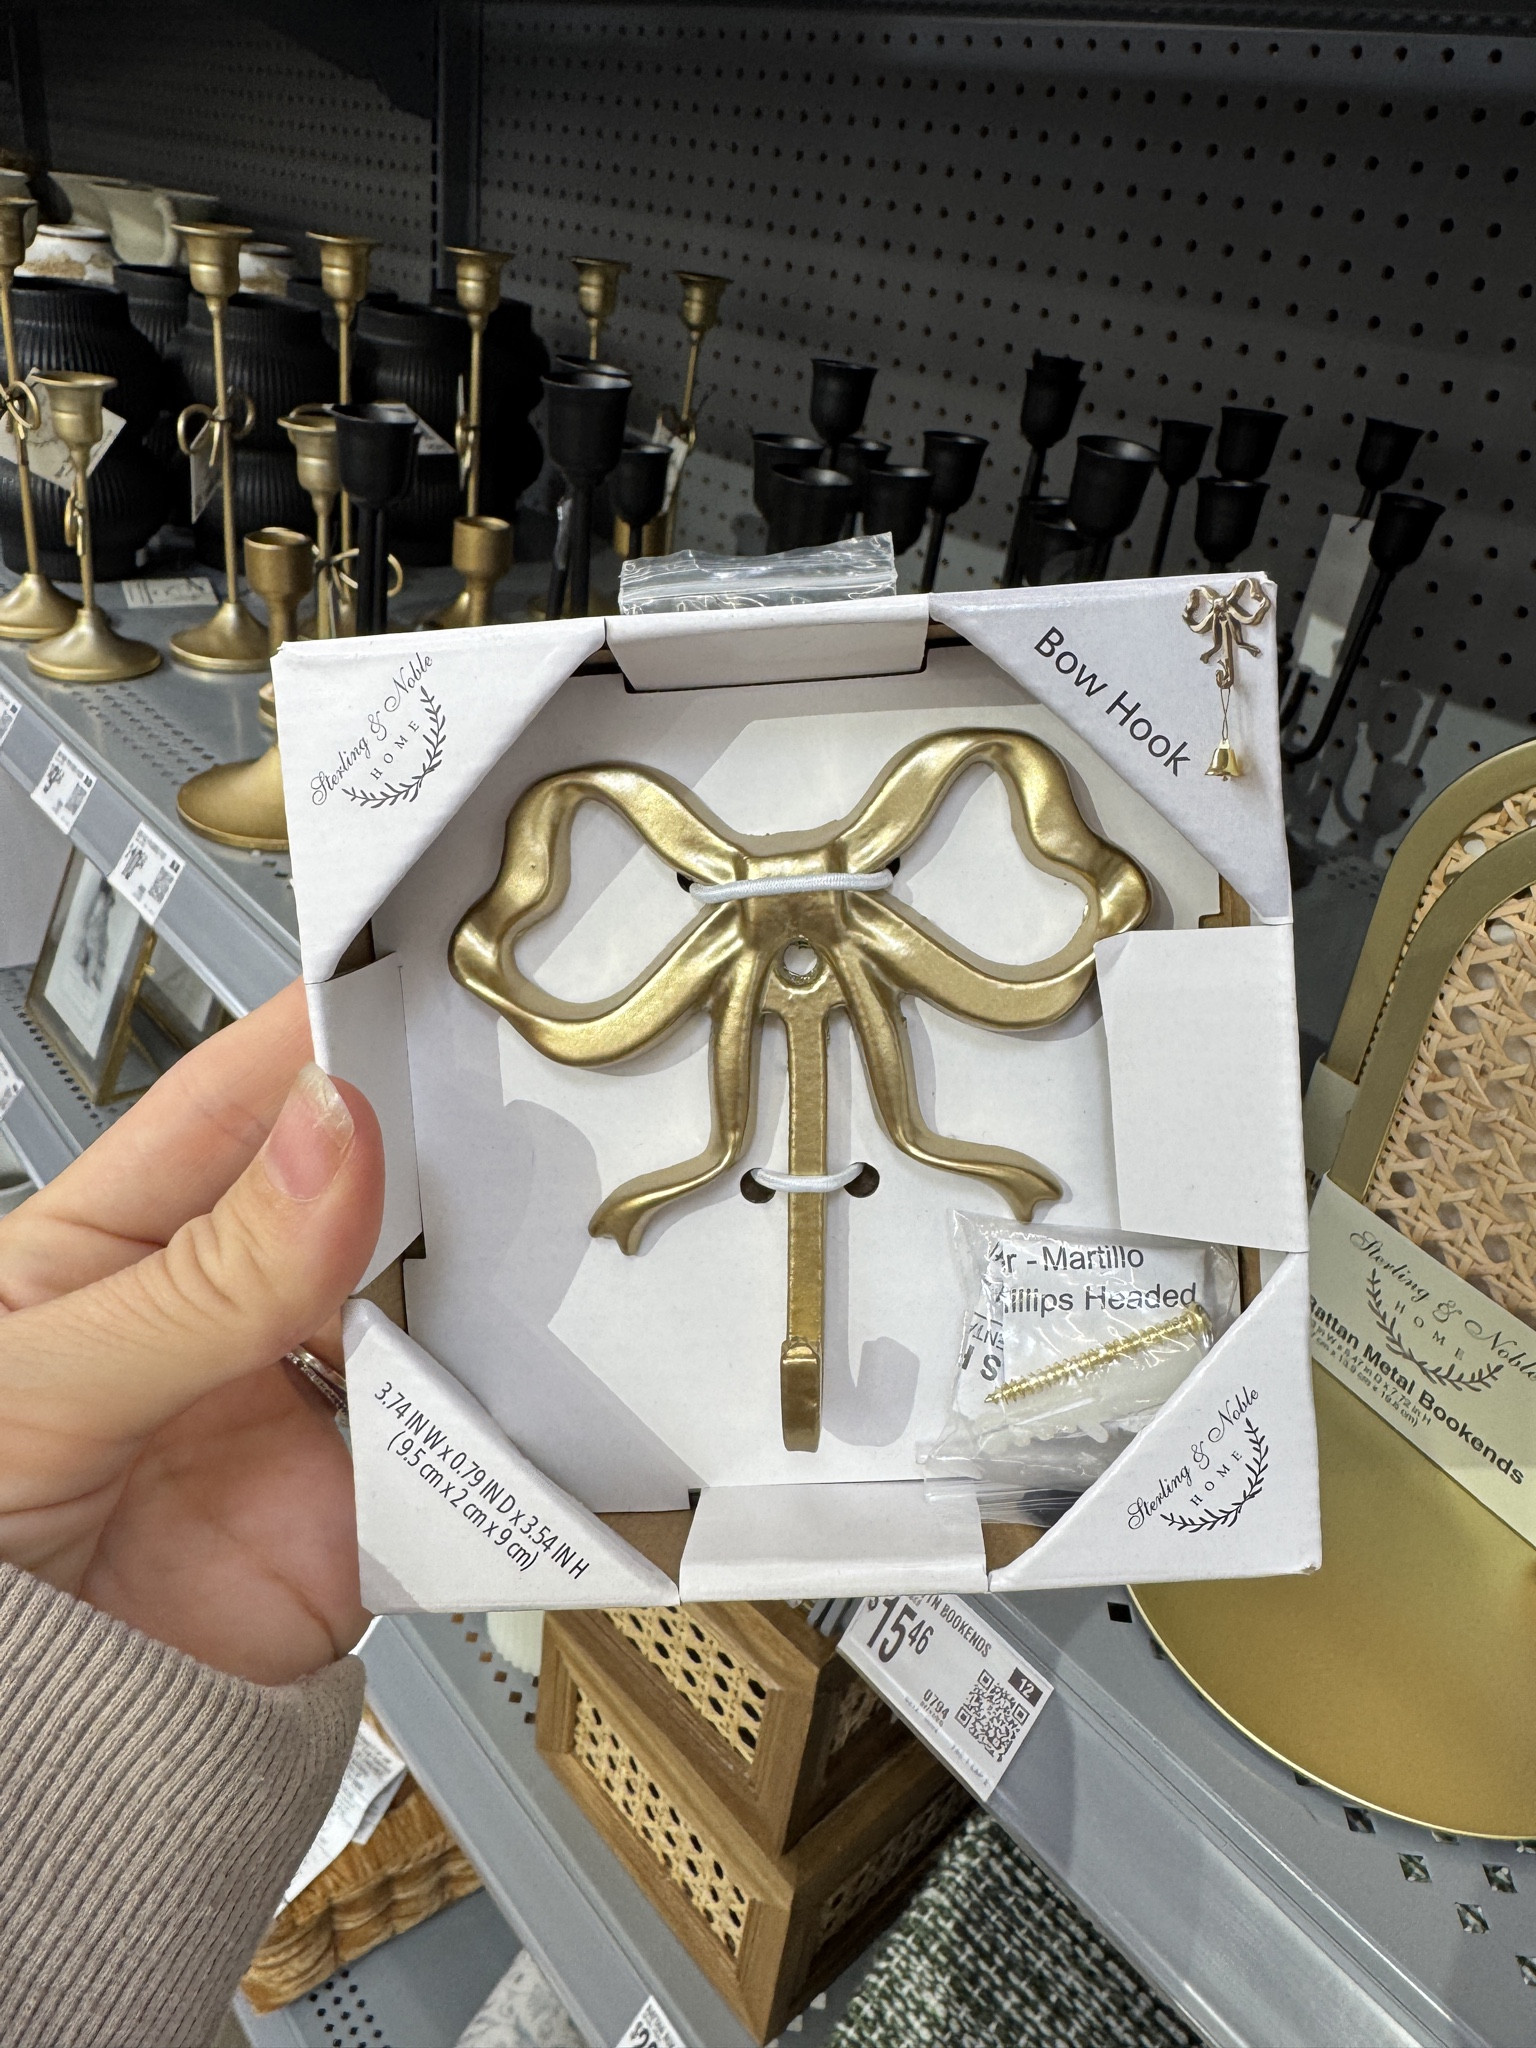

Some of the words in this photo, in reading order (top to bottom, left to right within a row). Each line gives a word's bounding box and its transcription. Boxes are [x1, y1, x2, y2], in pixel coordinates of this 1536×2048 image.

[311, 737, 371, 805] Sterling
[367, 710, 388, 741] &
[384, 652, 433, 712] Noble
[1034, 626, 1108, 697] Bow
[1105, 690, 1191, 777] Hook
[1042, 1245, 1144, 1271] Martillo
[1086, 1282, 1196, 1310] Headed
[1350, 1231, 1430, 1303] Sterling
[1432, 1300, 1463, 1323] &
[1464, 1319, 1536, 1381] Noble
[374, 1381, 412, 1420] 3.74
[404, 1409, 430, 1436] IN
[422, 1425, 448, 1451] W
[436, 1444, 455, 1462] x
[449, 1452, 487, 1488] 0.79
[479, 1478, 506, 1505] IN
[496, 1494, 516, 1514] D
[509, 1509, 526, 1527] x
[519, 1515, 559, 1553] 3.54
[550, 1542, 577, 1569] IN
[568, 1558, 591, 1580] H
[1127, 1466, 1192, 1530] Sterling
[1191, 1441, 1210, 1470] &
[1208, 1386, 1259, 1443] Noble
[1363, 1343, 1415, 1395] Metal
[1418, 1389, 1524, 1484] Bookends
[419, 1463, 444, 1488] cm
[439, 1481, 456, 1499] x
[449, 1488, 468, 1508] 2
[462, 1503, 488, 1528] cm
[483, 1520, 501, 1538] x
[494, 1528, 512, 1546] 9
[506, 1542, 540, 1572] cm)
[940, 1603, 992, 1657] BOOKENDS
[1019, 1678, 1035, 1699] 12
